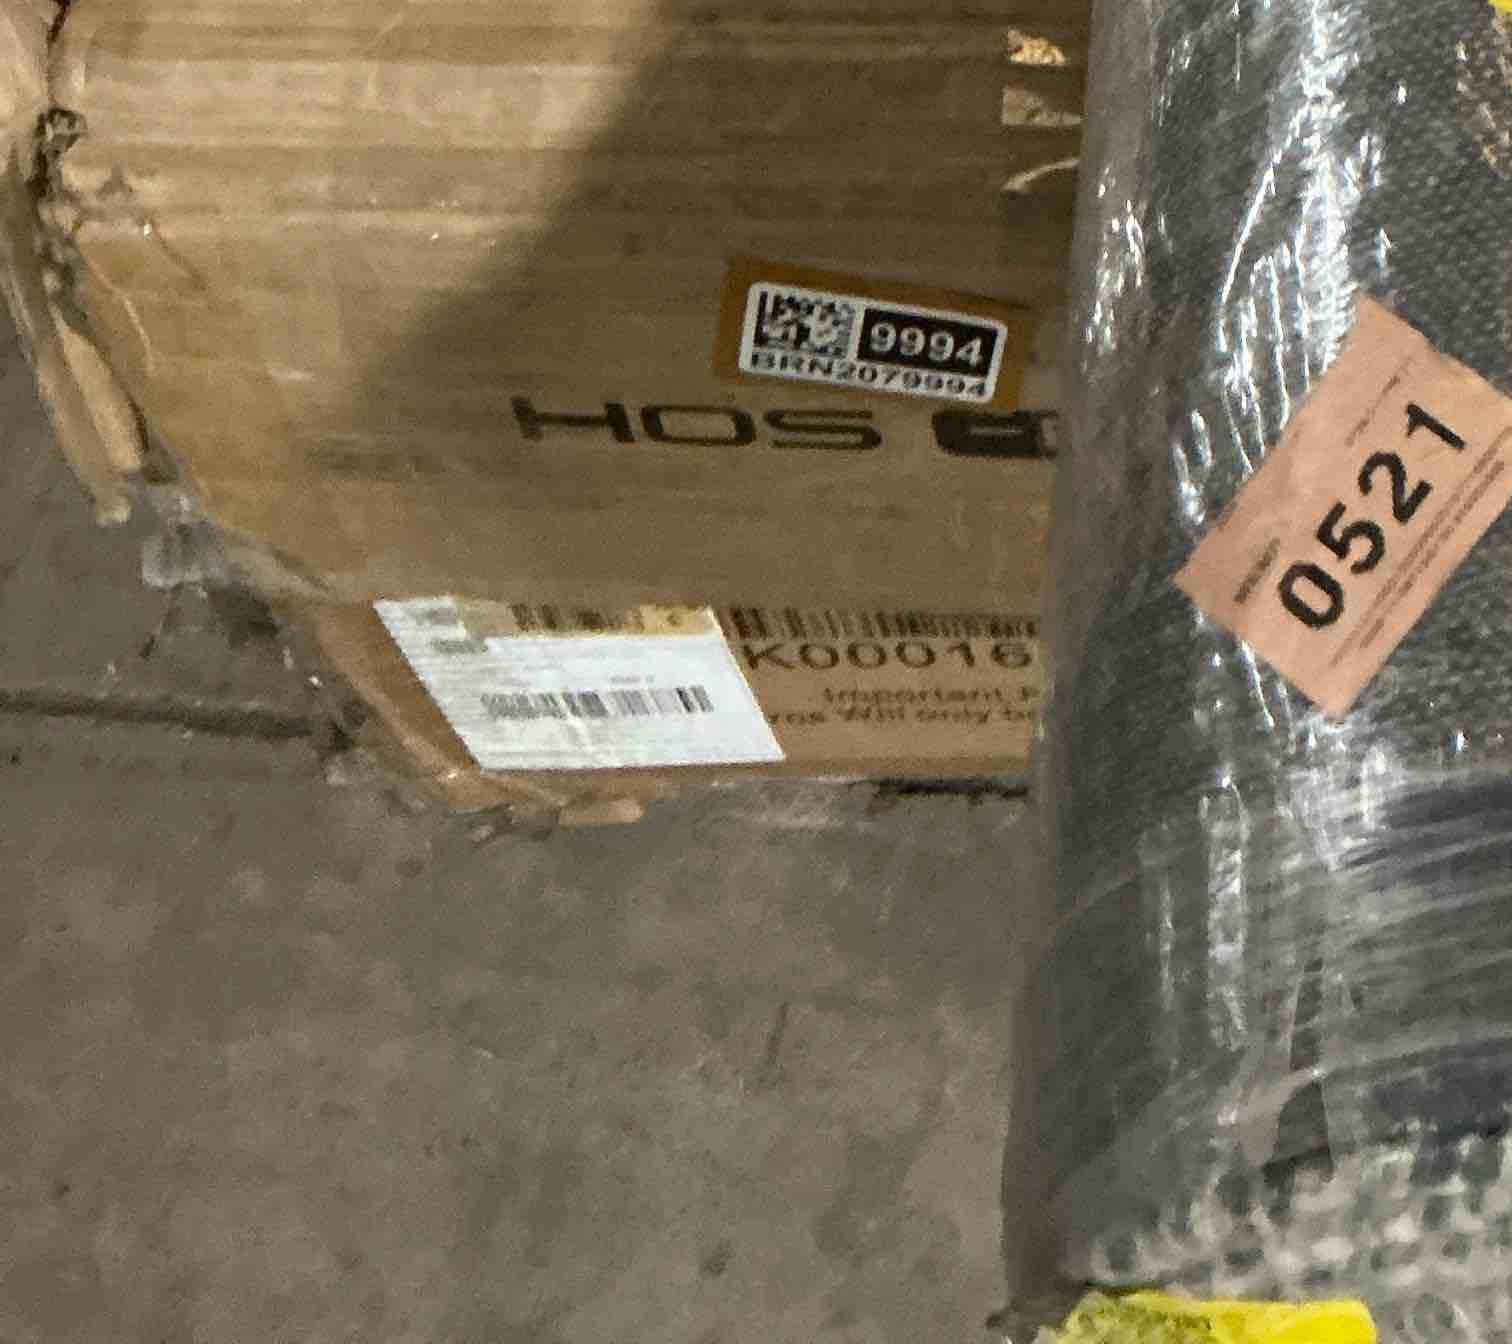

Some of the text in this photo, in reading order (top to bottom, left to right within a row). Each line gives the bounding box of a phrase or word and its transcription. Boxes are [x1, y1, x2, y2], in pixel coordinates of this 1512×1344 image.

[868, 321, 984, 369] 9994
[749, 351, 988, 398] BRN2079994
[511, 395, 883, 451] HOS
[1277, 401, 1467, 630] 0521
